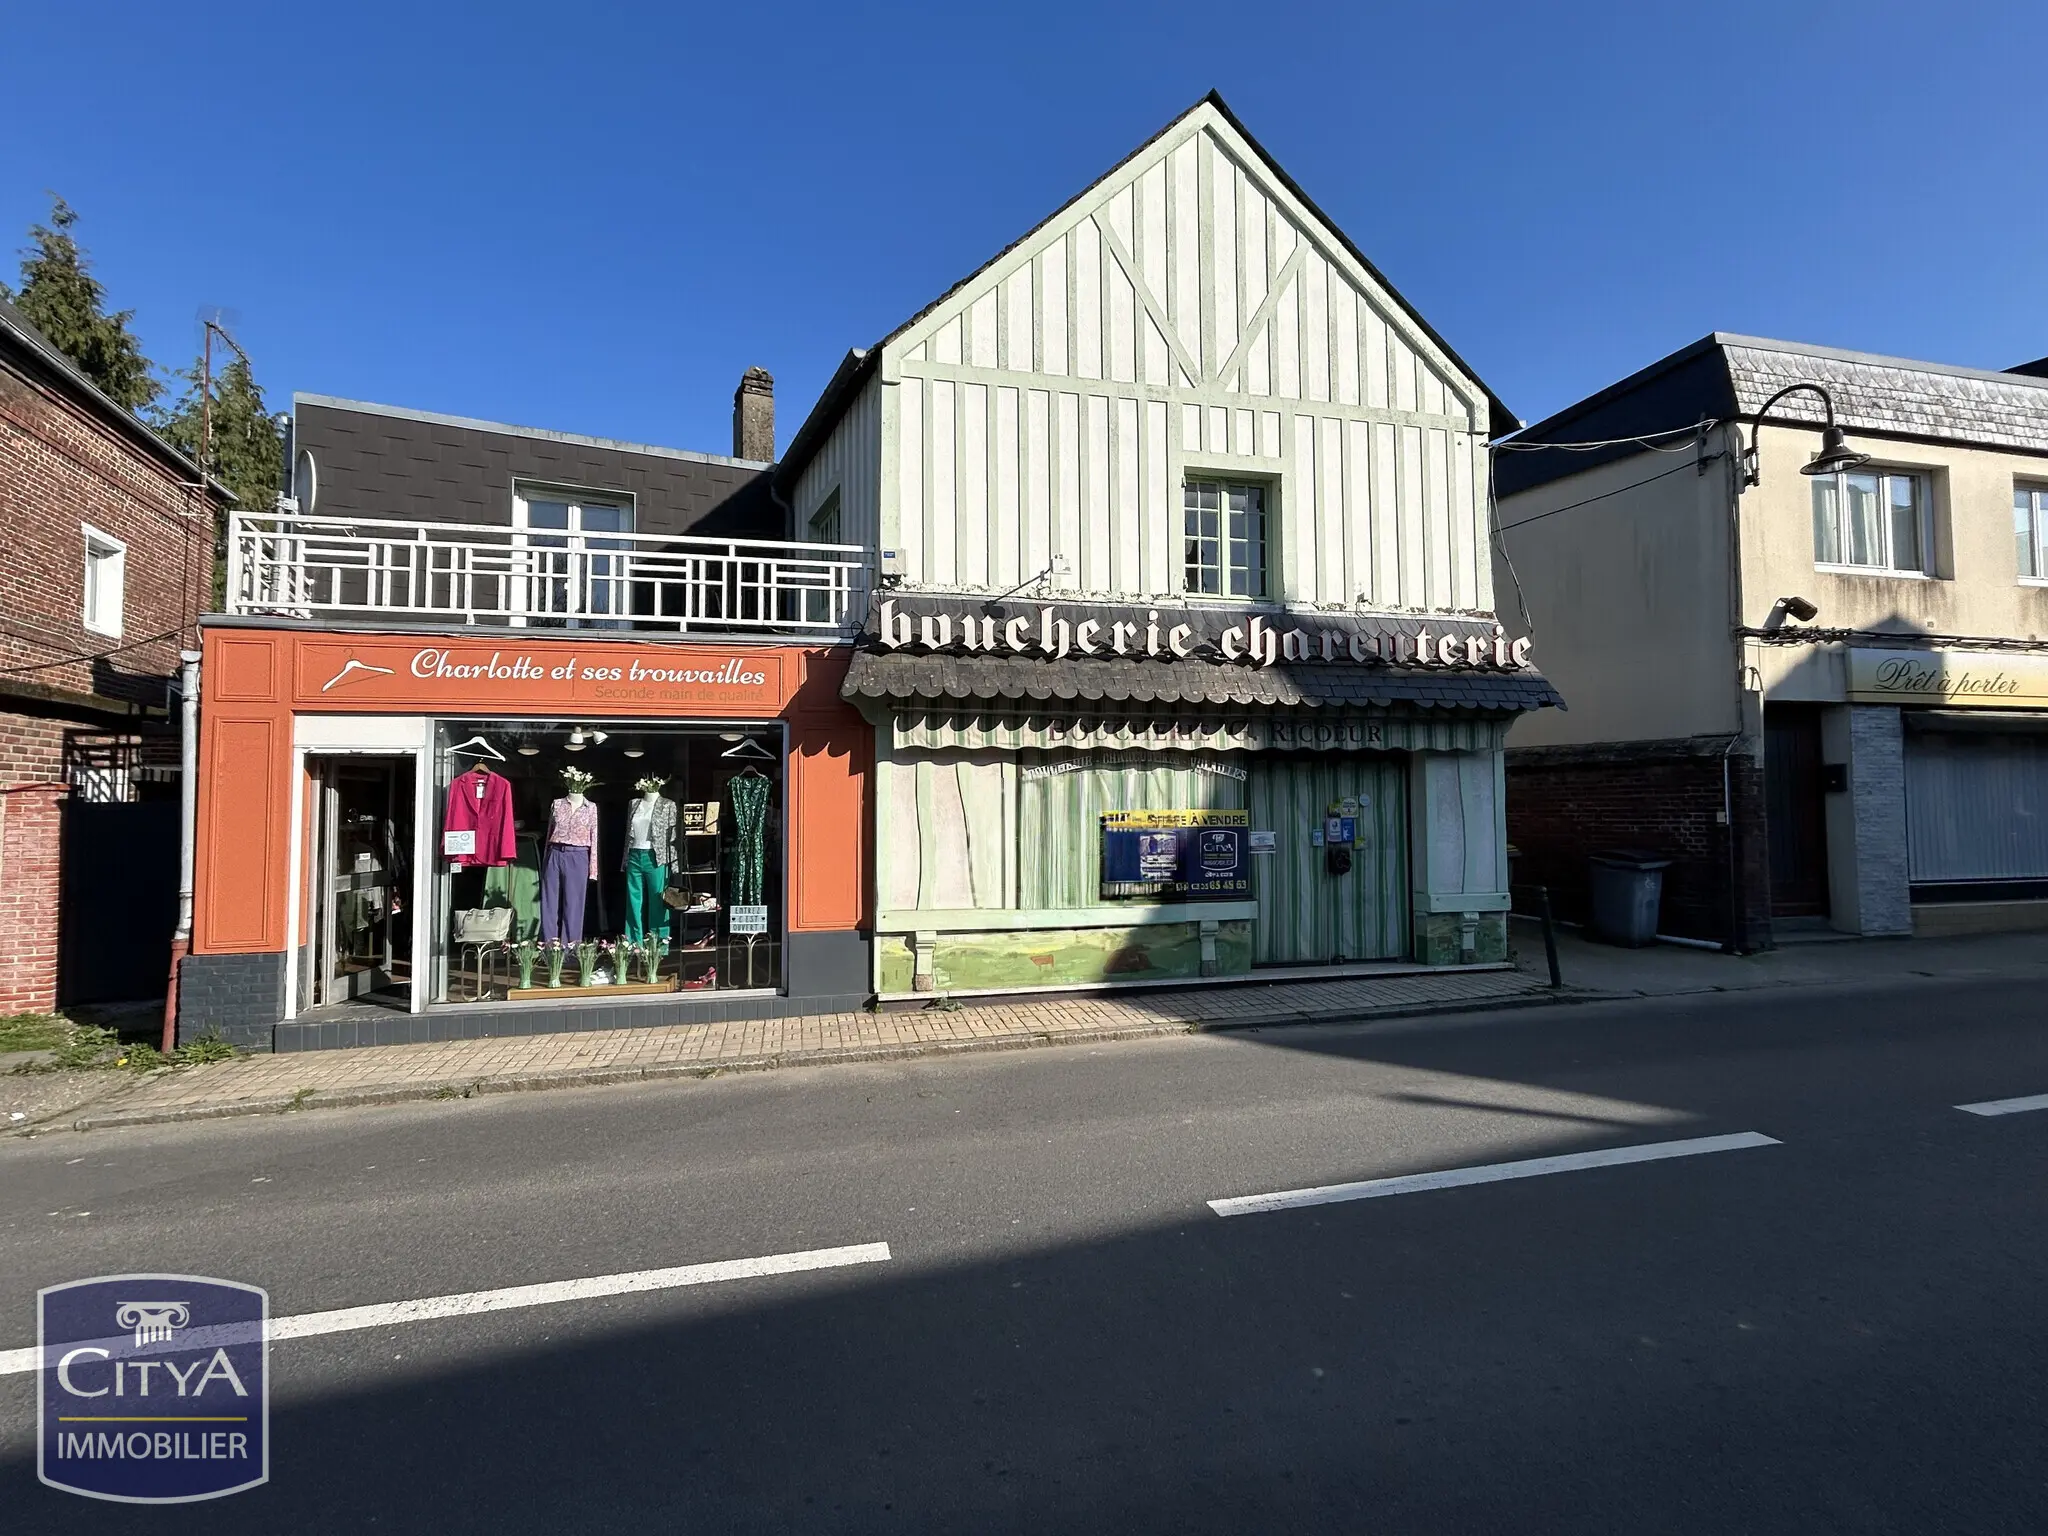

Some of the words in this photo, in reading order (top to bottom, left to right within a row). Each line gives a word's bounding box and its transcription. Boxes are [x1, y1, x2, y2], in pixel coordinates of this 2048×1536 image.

[878, 599, 1193, 661] boucherie
[1220, 616, 1533, 668] charcuterie
[410, 648, 545, 680] Charlotte
[551, 657, 577, 680] et
[581, 666, 622, 681] ses
[629, 658, 766, 685] trouvailles
[1874, 657, 1937, 691] Prêt
[1937, 671, 1954, 692] à
[1949, 671, 2020, 700] porter
[594, 685, 655, 699] Seconde
[659, 687, 692, 700] main
[697, 688, 715, 700] de
[718, 688, 763, 703] qualité
[1201, 815, 1247, 826] VENDRE
